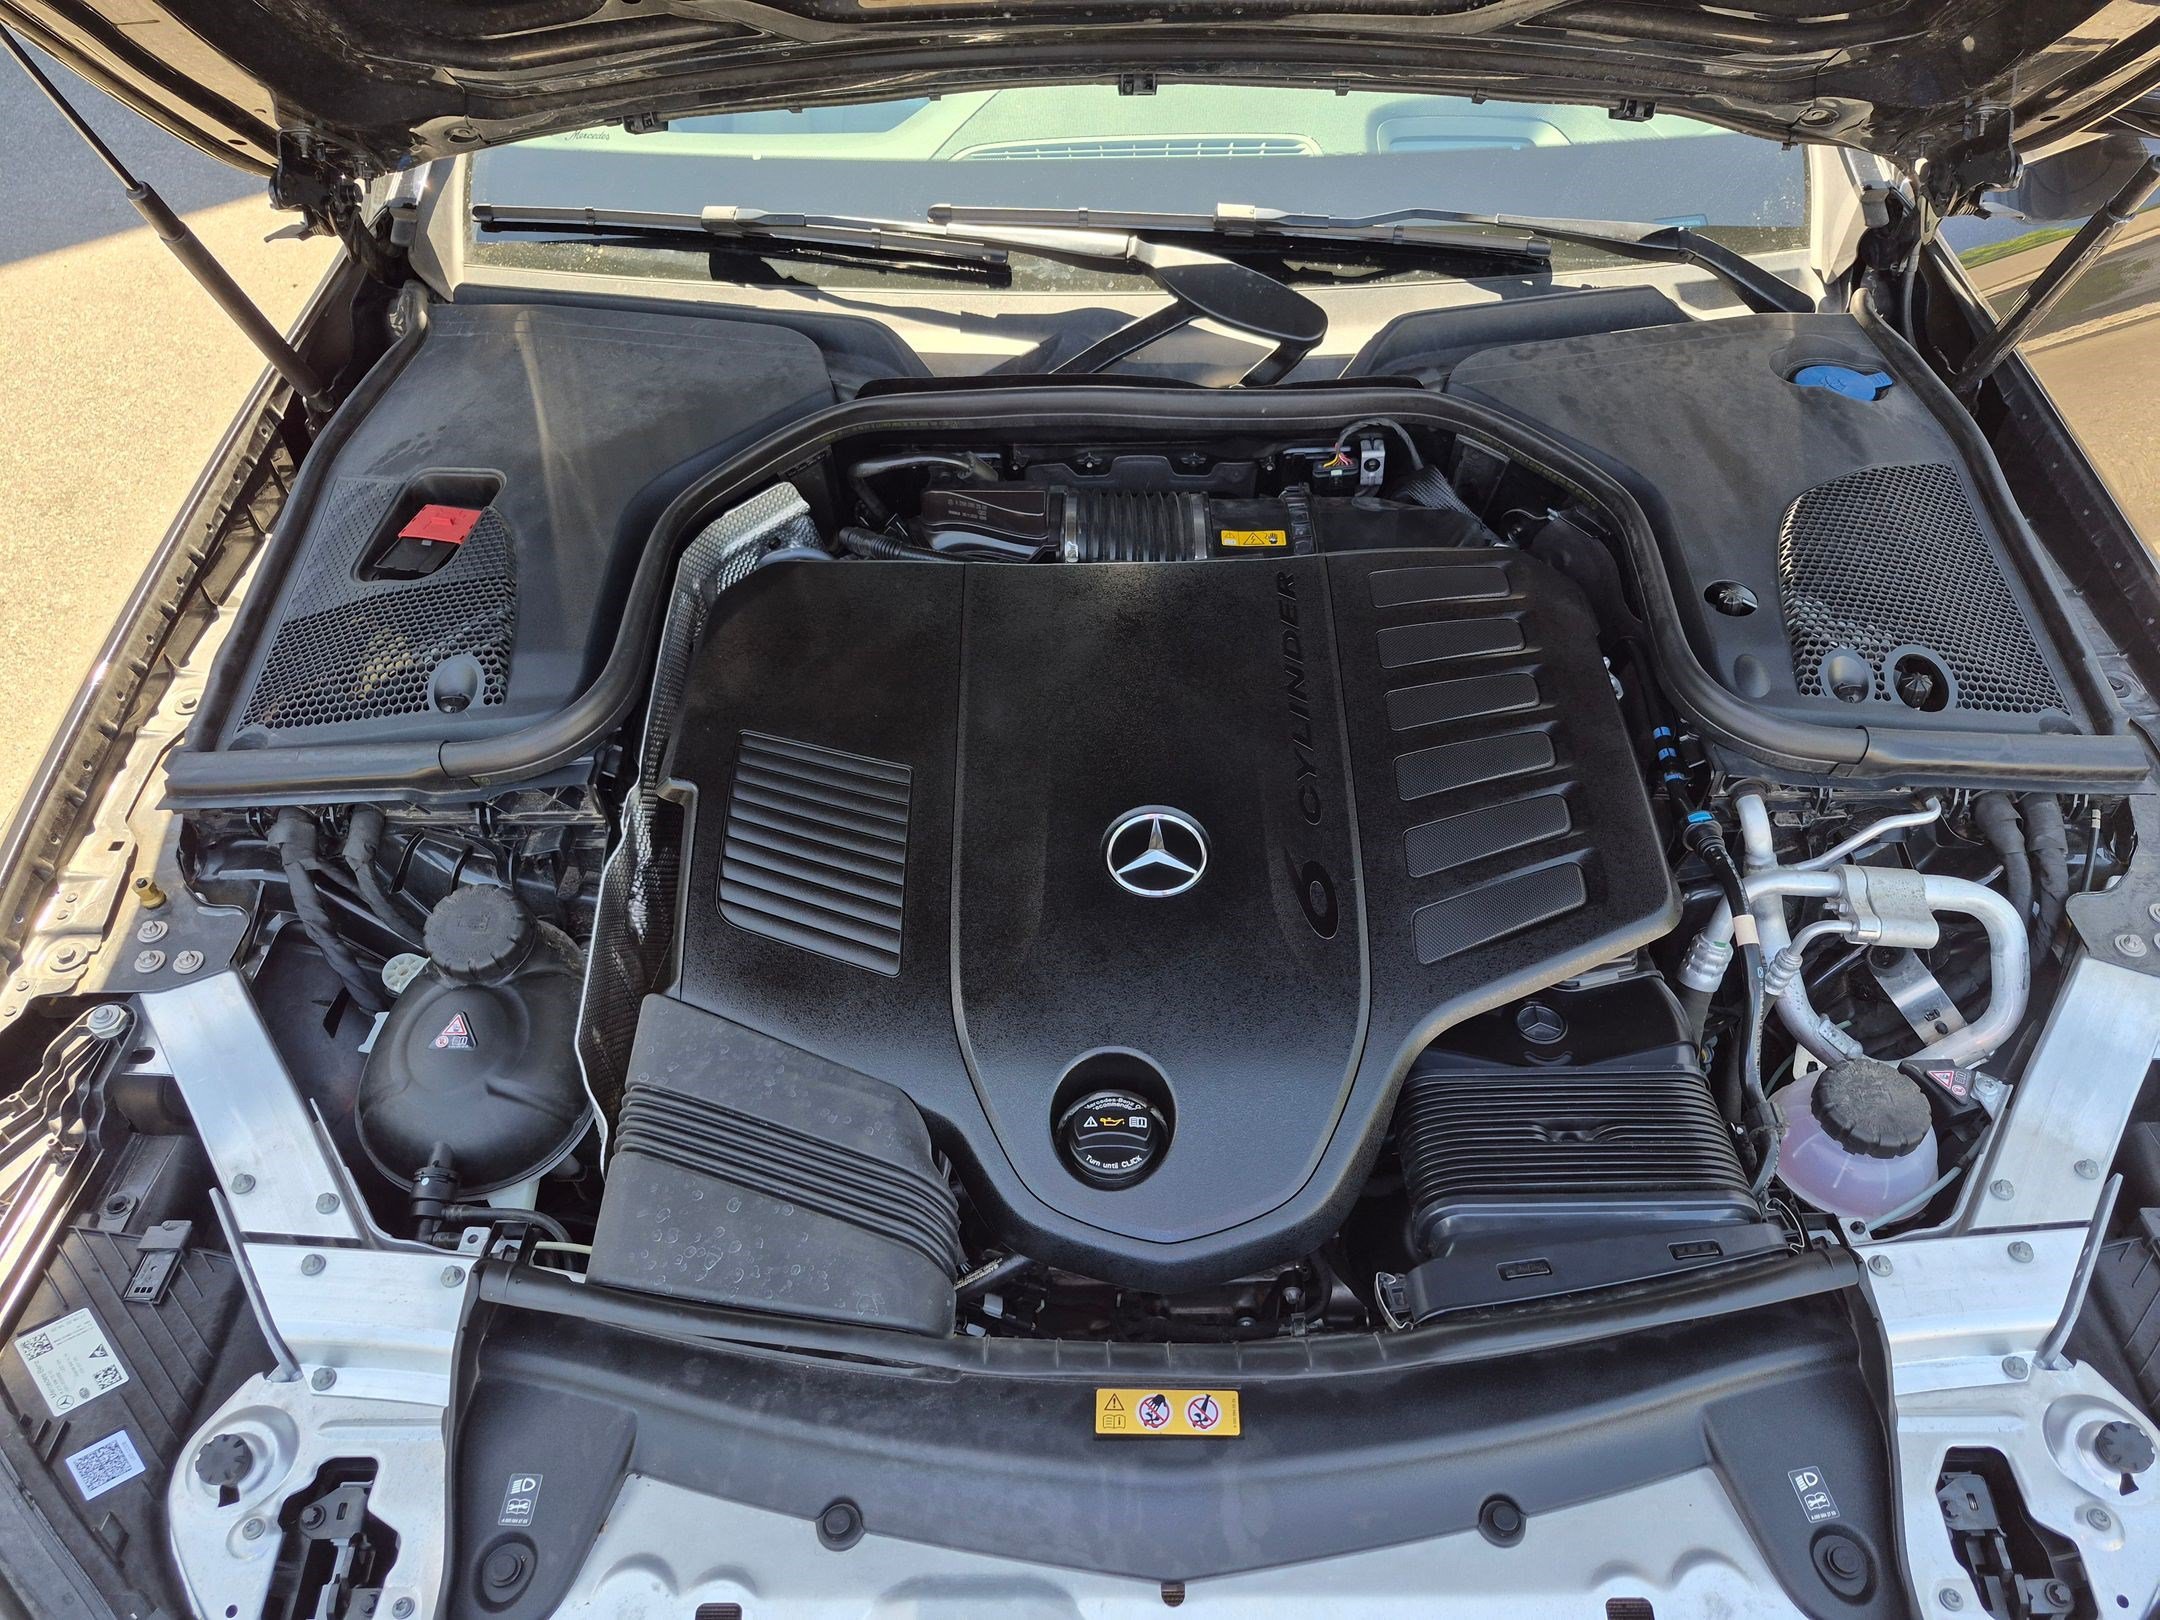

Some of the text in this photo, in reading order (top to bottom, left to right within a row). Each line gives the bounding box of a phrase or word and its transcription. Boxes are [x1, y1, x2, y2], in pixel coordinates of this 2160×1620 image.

[564, 129, 610, 141] Mercedes
[1276, 571, 1340, 939] 6 CYLINDER
[1092, 1102, 1136, 1111] ecommende
[1086, 1154, 1101, 1167] Turn
[1121, 1154, 1142, 1168] CLICK
